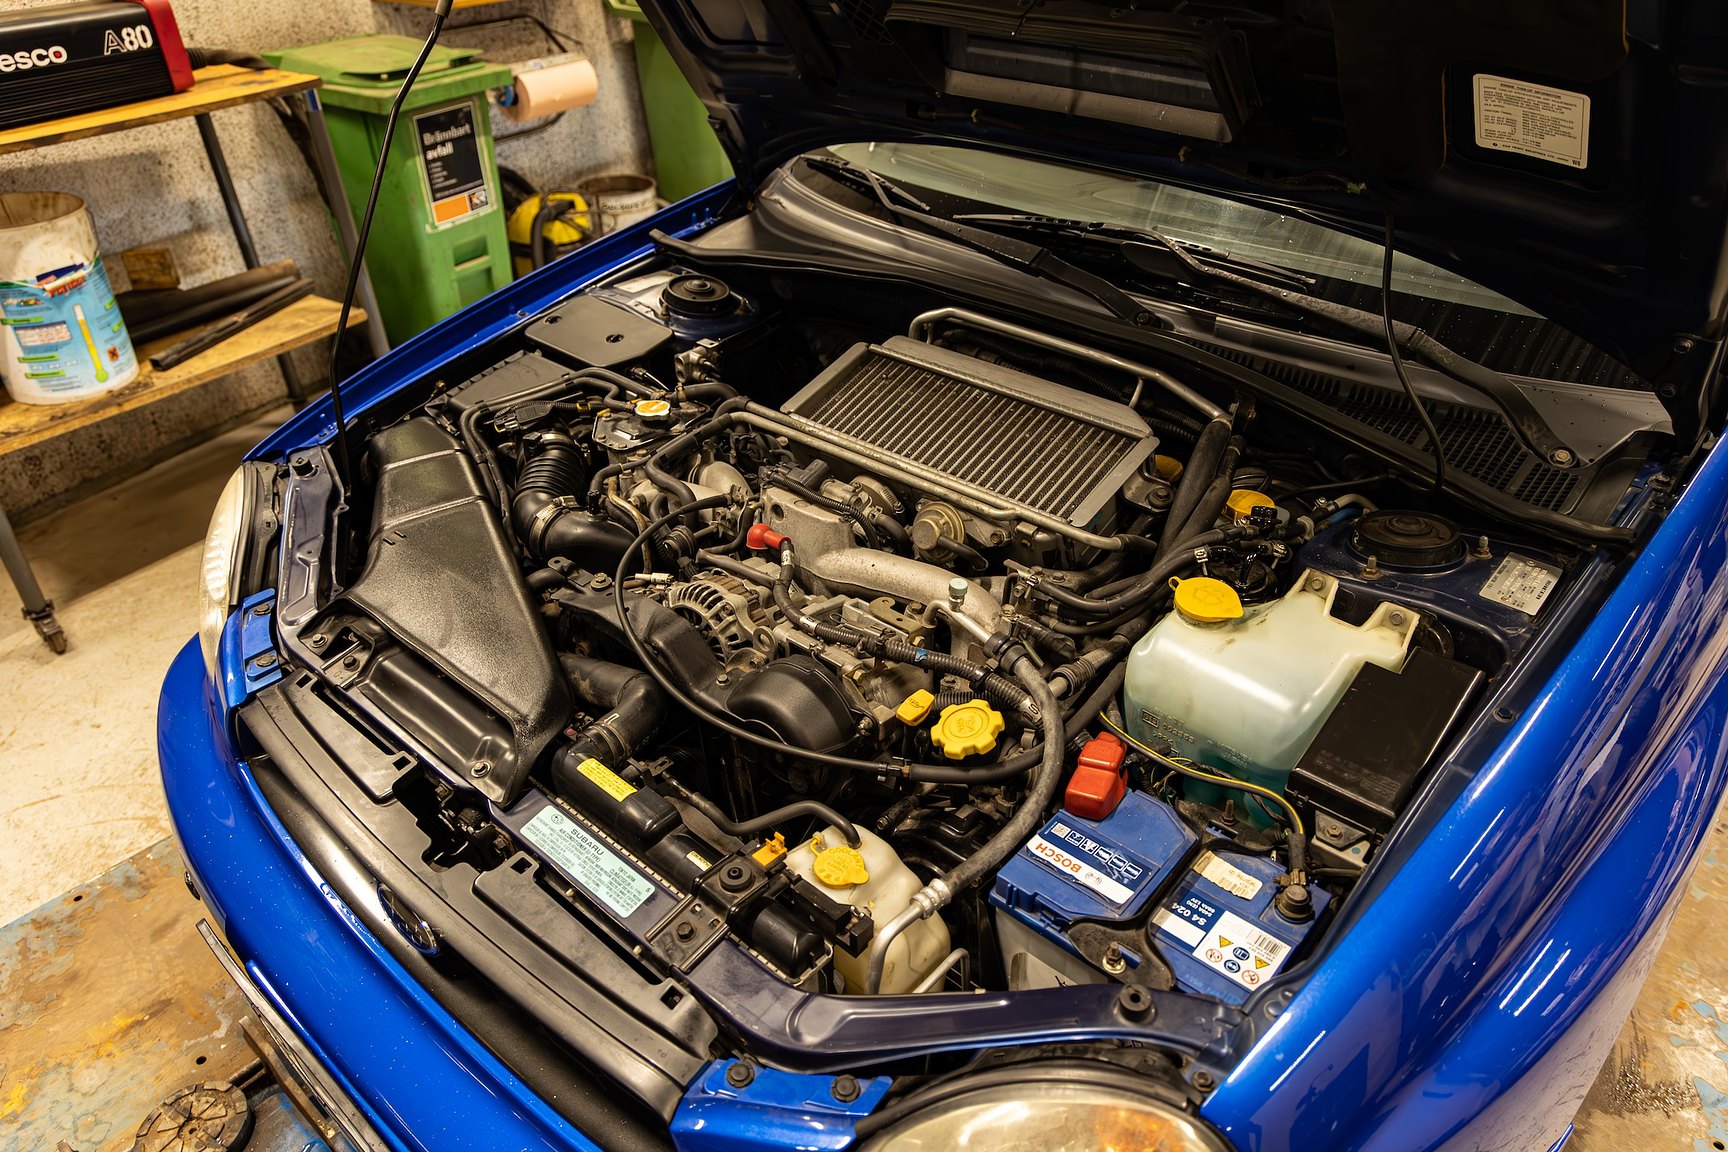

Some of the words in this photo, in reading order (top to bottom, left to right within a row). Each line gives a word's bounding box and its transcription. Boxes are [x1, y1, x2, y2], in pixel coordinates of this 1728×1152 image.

[104, 24, 153, 55] A80
[426, 141, 454, 160] avfall
[570, 828, 604, 856] SUBARU
[1035, 843, 1082, 873] BOSCH
[1171, 902, 1192, 917] 024
[1191, 914, 1207, 926] S4
